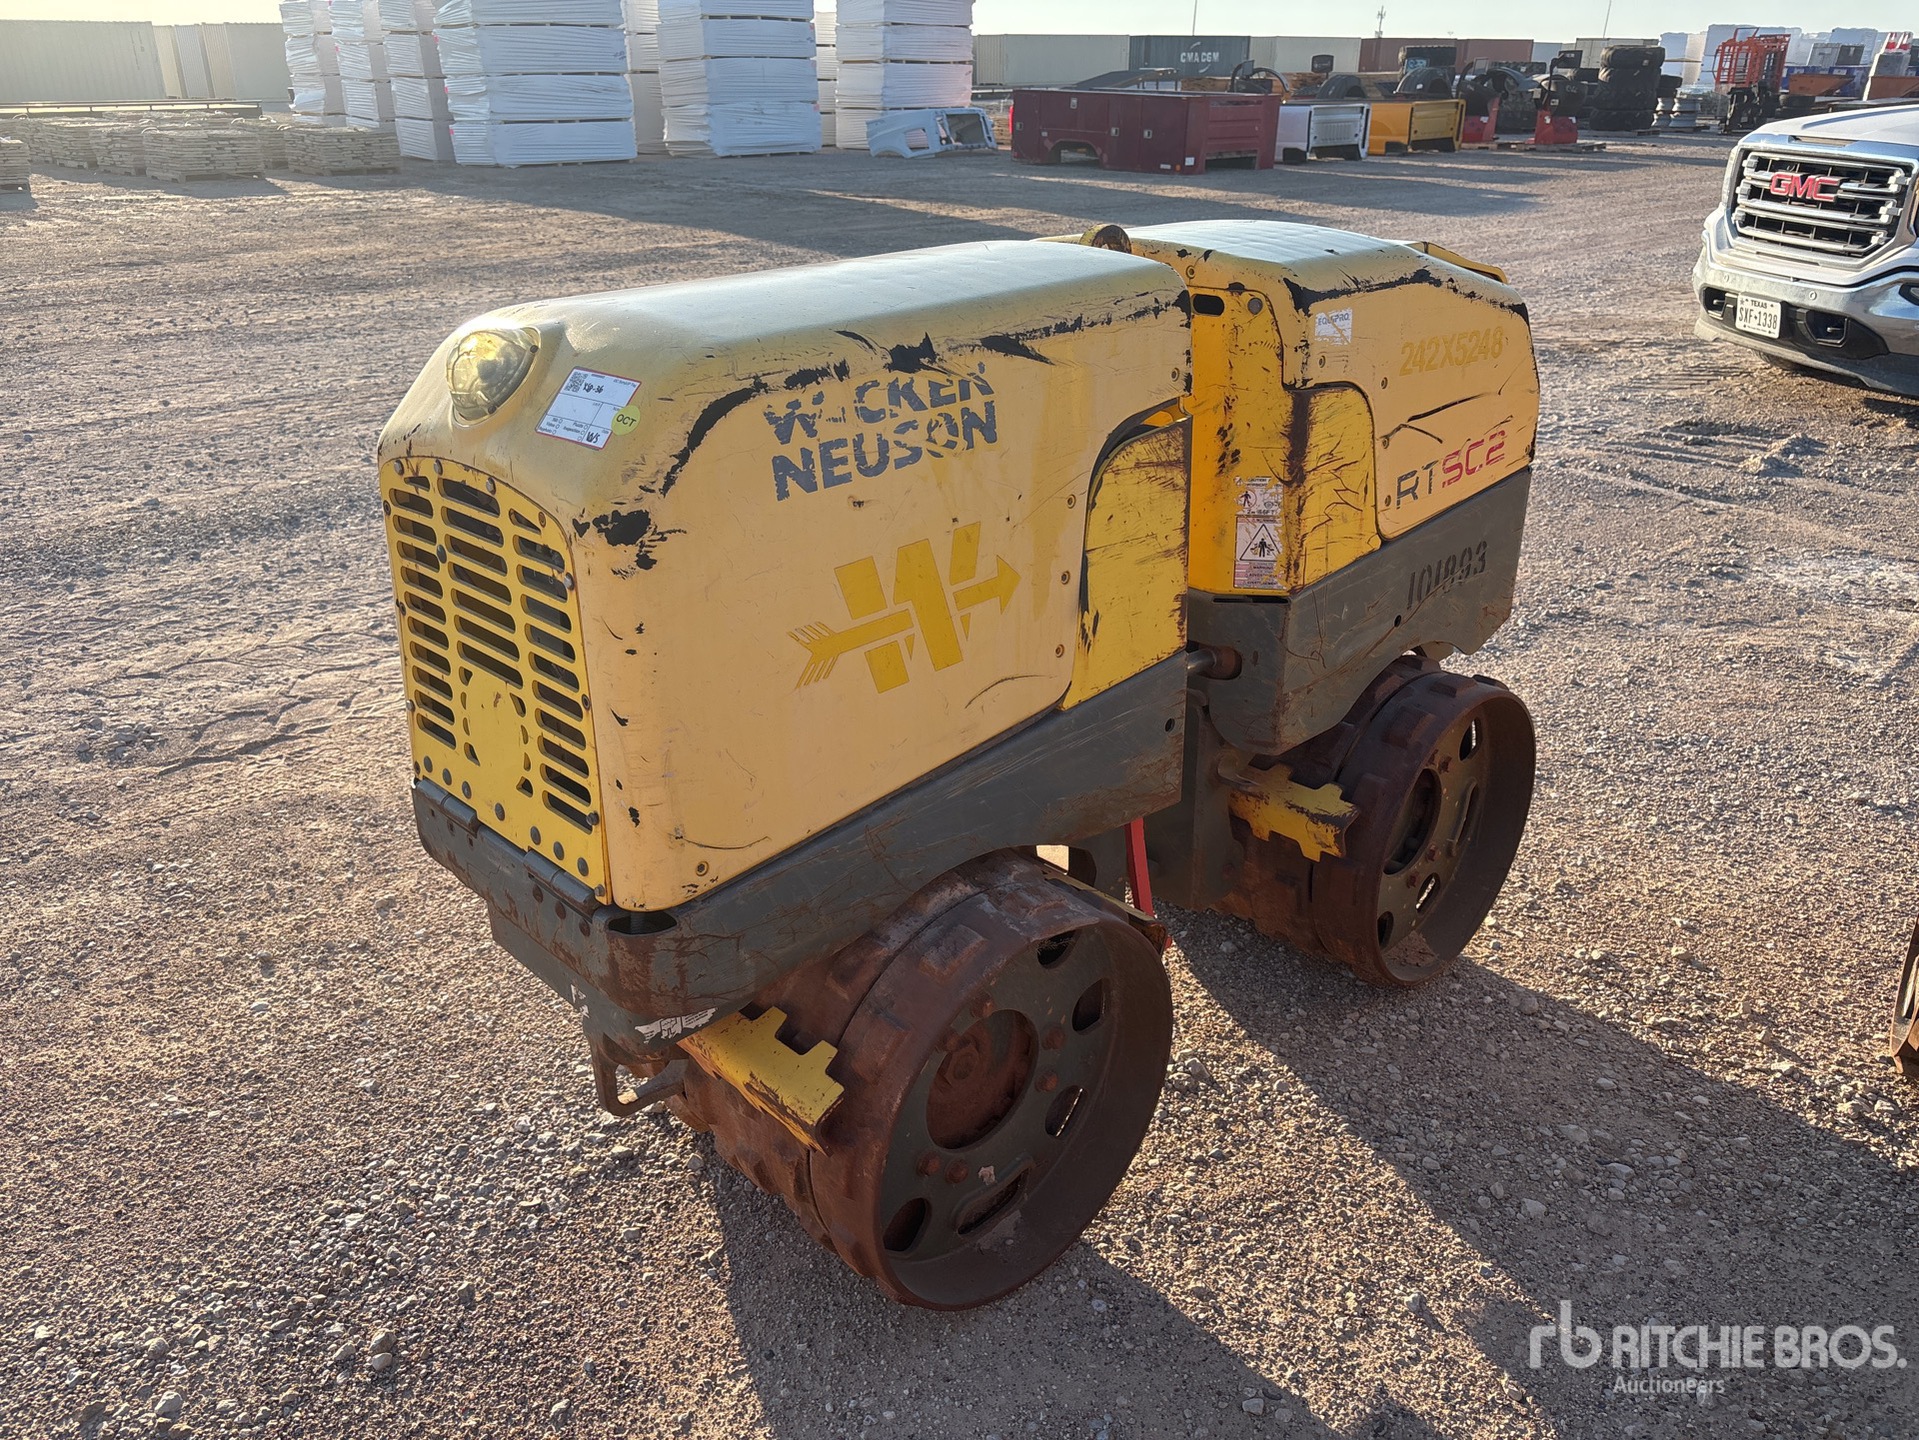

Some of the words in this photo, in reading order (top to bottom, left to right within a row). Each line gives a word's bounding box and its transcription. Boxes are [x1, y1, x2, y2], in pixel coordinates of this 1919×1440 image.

[1180, 51, 1200, 63] CMA
[1201, 51, 1220, 63] CGM
[1769, 172, 1841, 202] GMC
[1750, 299, 1768, 309] TEXAS
[1399, 325, 1504, 377] 242X5248
[763, 361, 995, 445] WCKER
[616, 413, 637, 428] OCT
[771, 400, 998, 501] NEUSON
